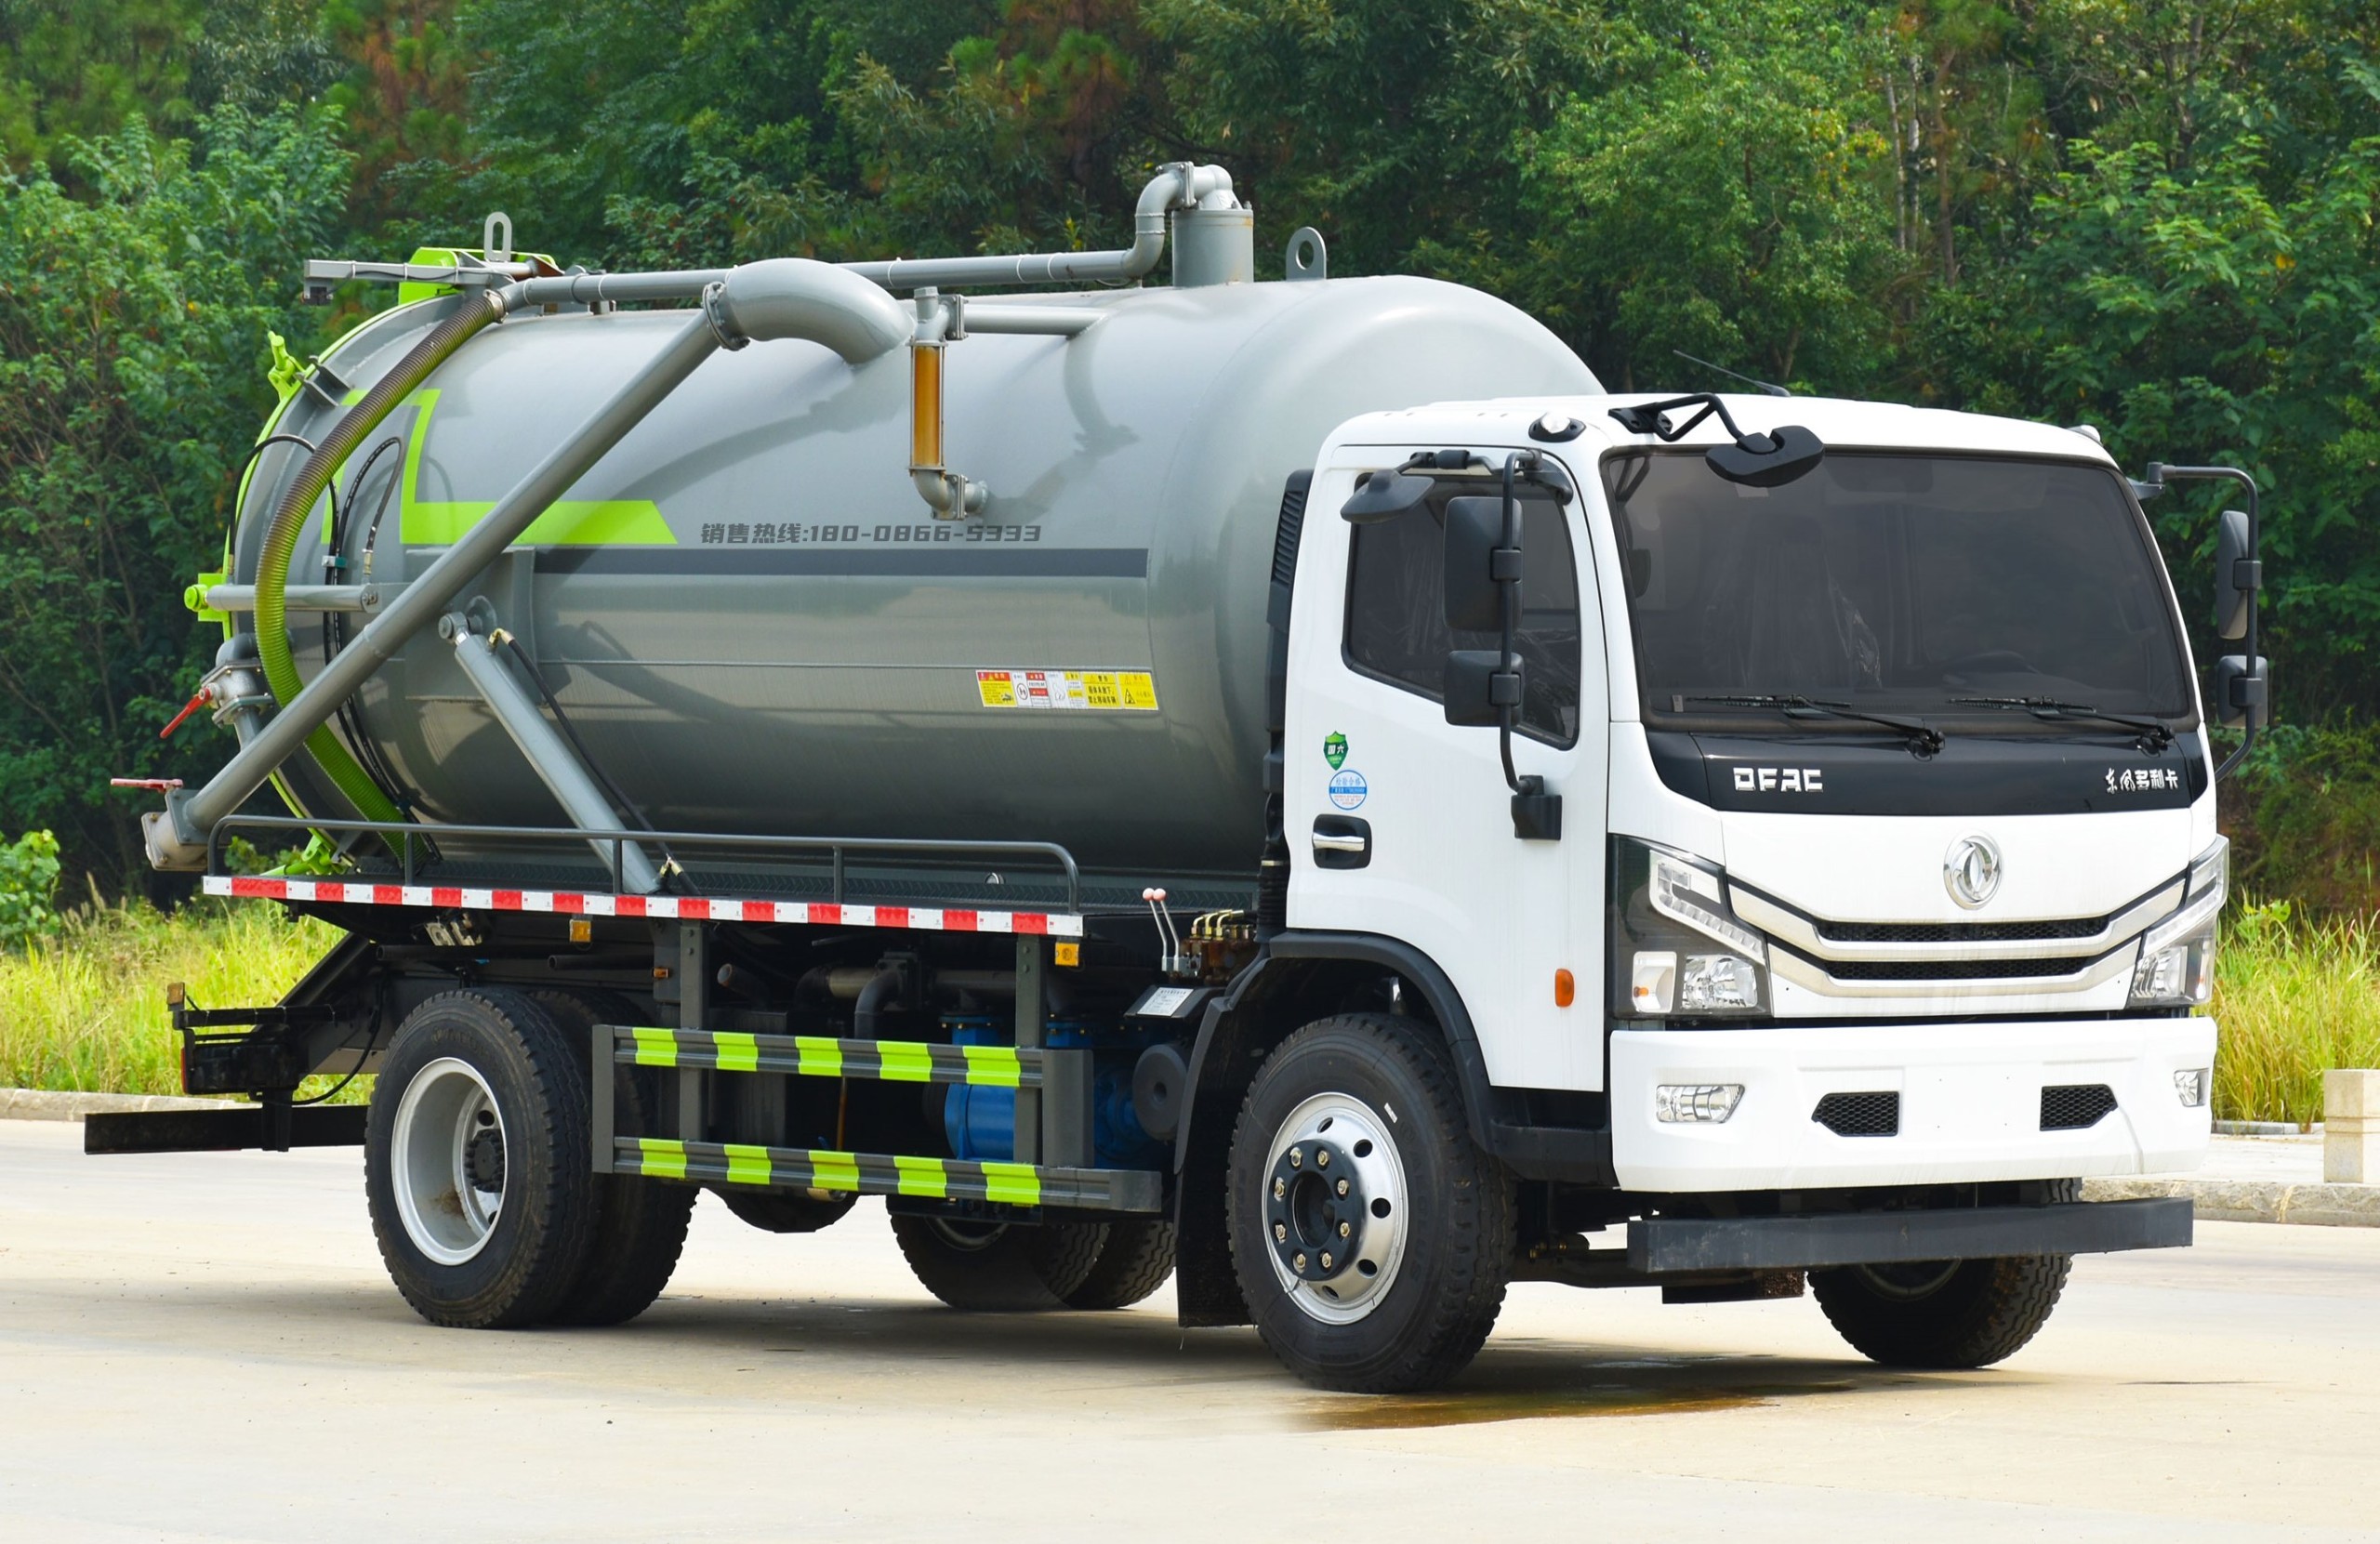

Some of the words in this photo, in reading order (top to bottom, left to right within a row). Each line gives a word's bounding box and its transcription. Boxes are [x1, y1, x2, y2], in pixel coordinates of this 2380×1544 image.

[701, 522, 1041, 544] 销售热线:180-0866-5333
[1733, 767, 1823, 792] DFAC
[2105, 767, 2179, 794] 东风多利卡
